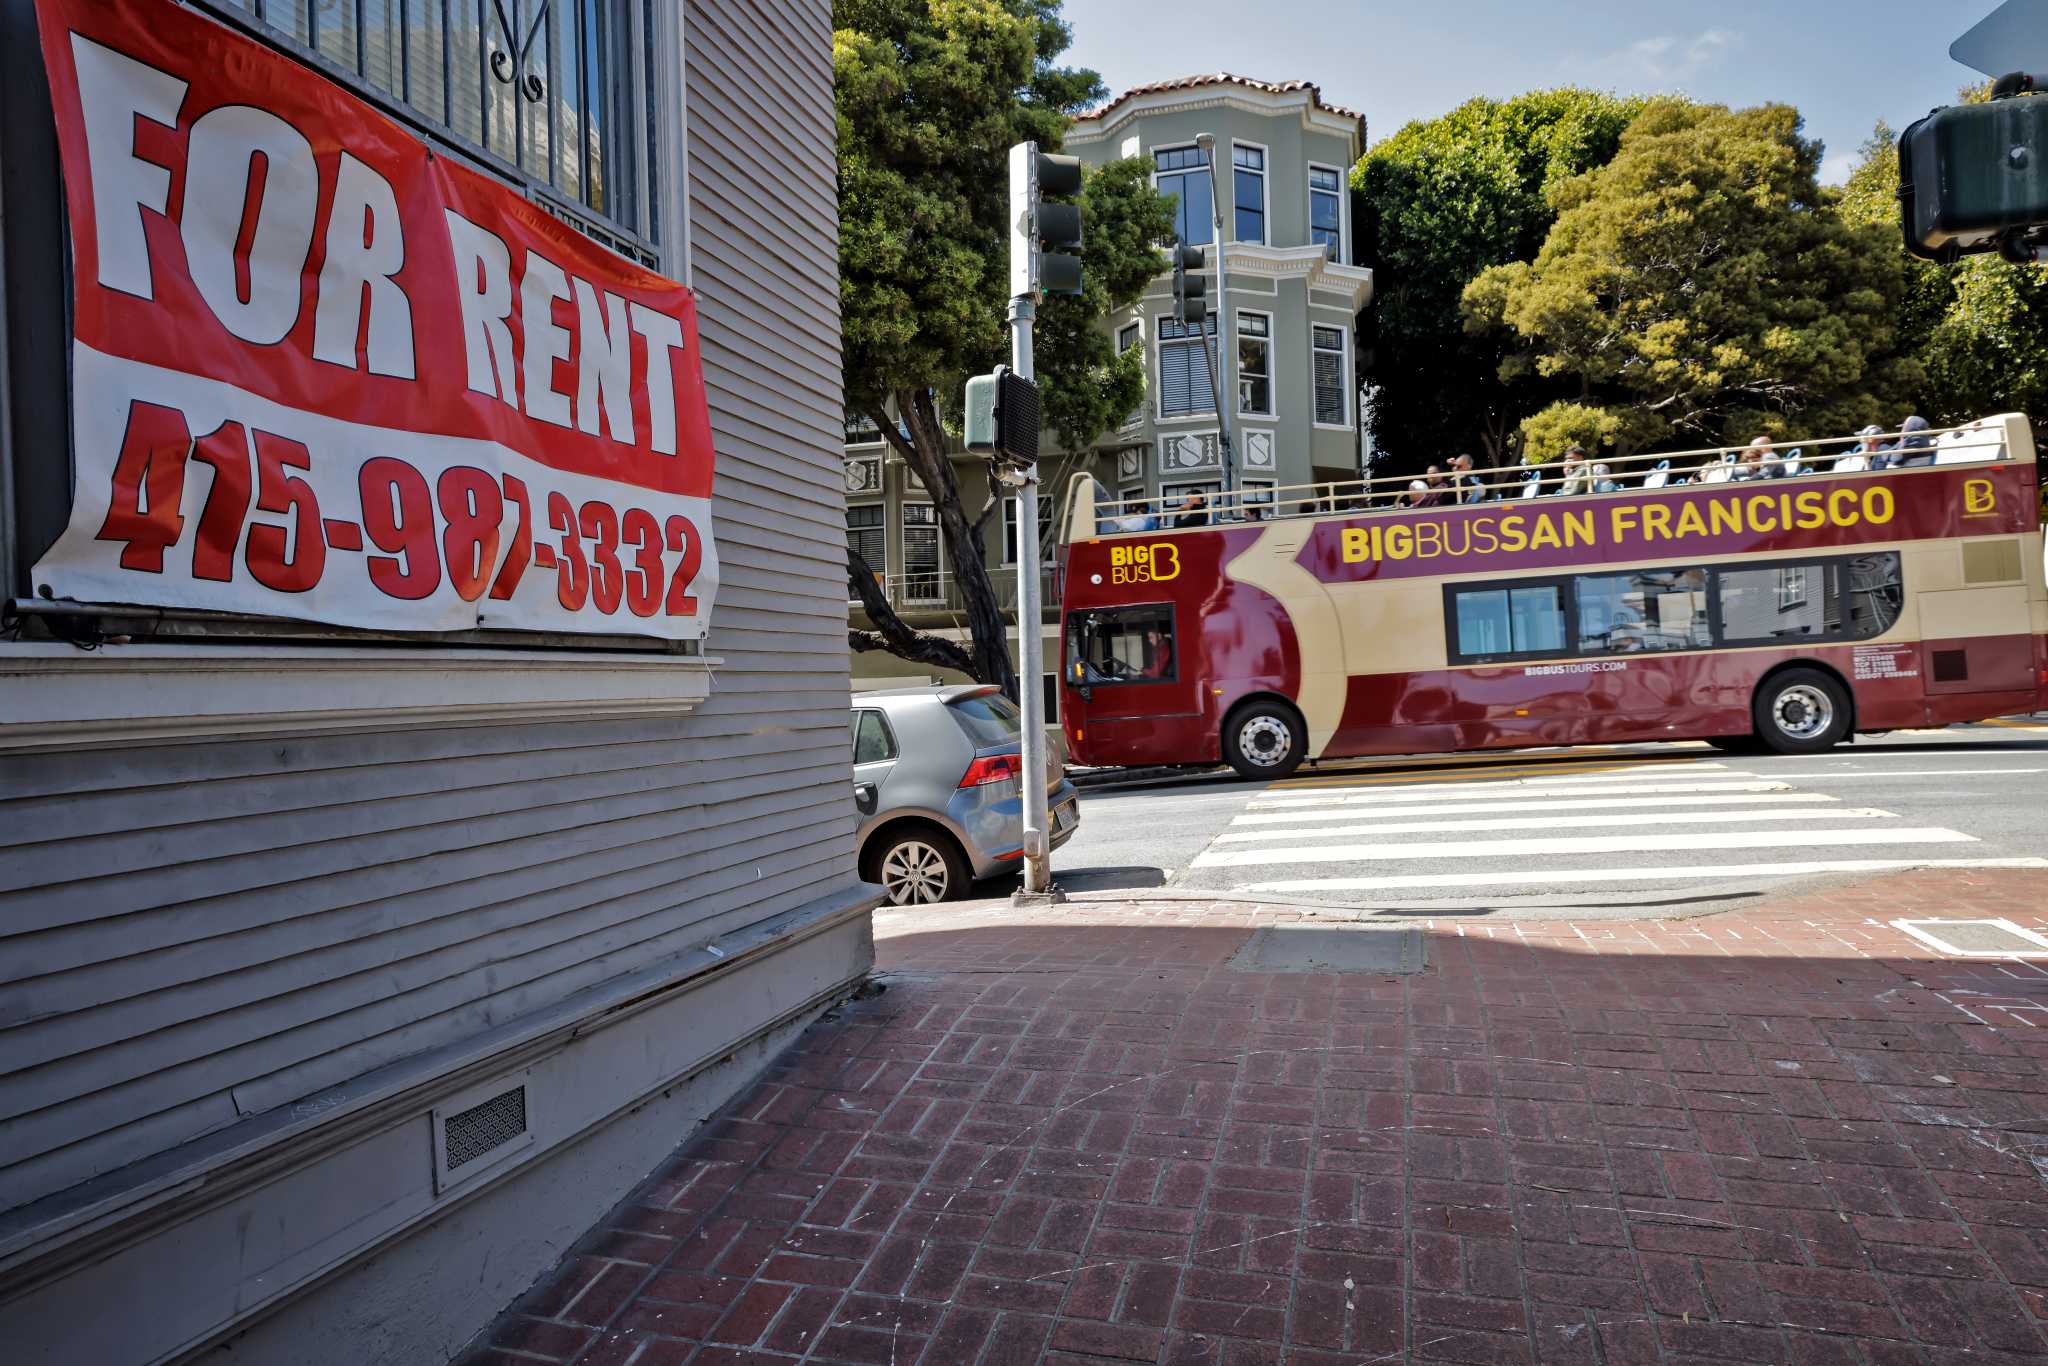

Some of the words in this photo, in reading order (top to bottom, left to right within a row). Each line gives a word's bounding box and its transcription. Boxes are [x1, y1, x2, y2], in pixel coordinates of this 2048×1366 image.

[69, 29, 416, 381] FOR
[444, 207, 684, 456] RENT
[95, 399, 701, 617] 415-987-3332
[1611, 486, 1896, 544] FRANCISCO
[1111, 545, 1149, 566] BIG
[1112, 565, 1150, 585] BUS
[1525, 661, 1627, 676] BIGBUSTOURS.COM
